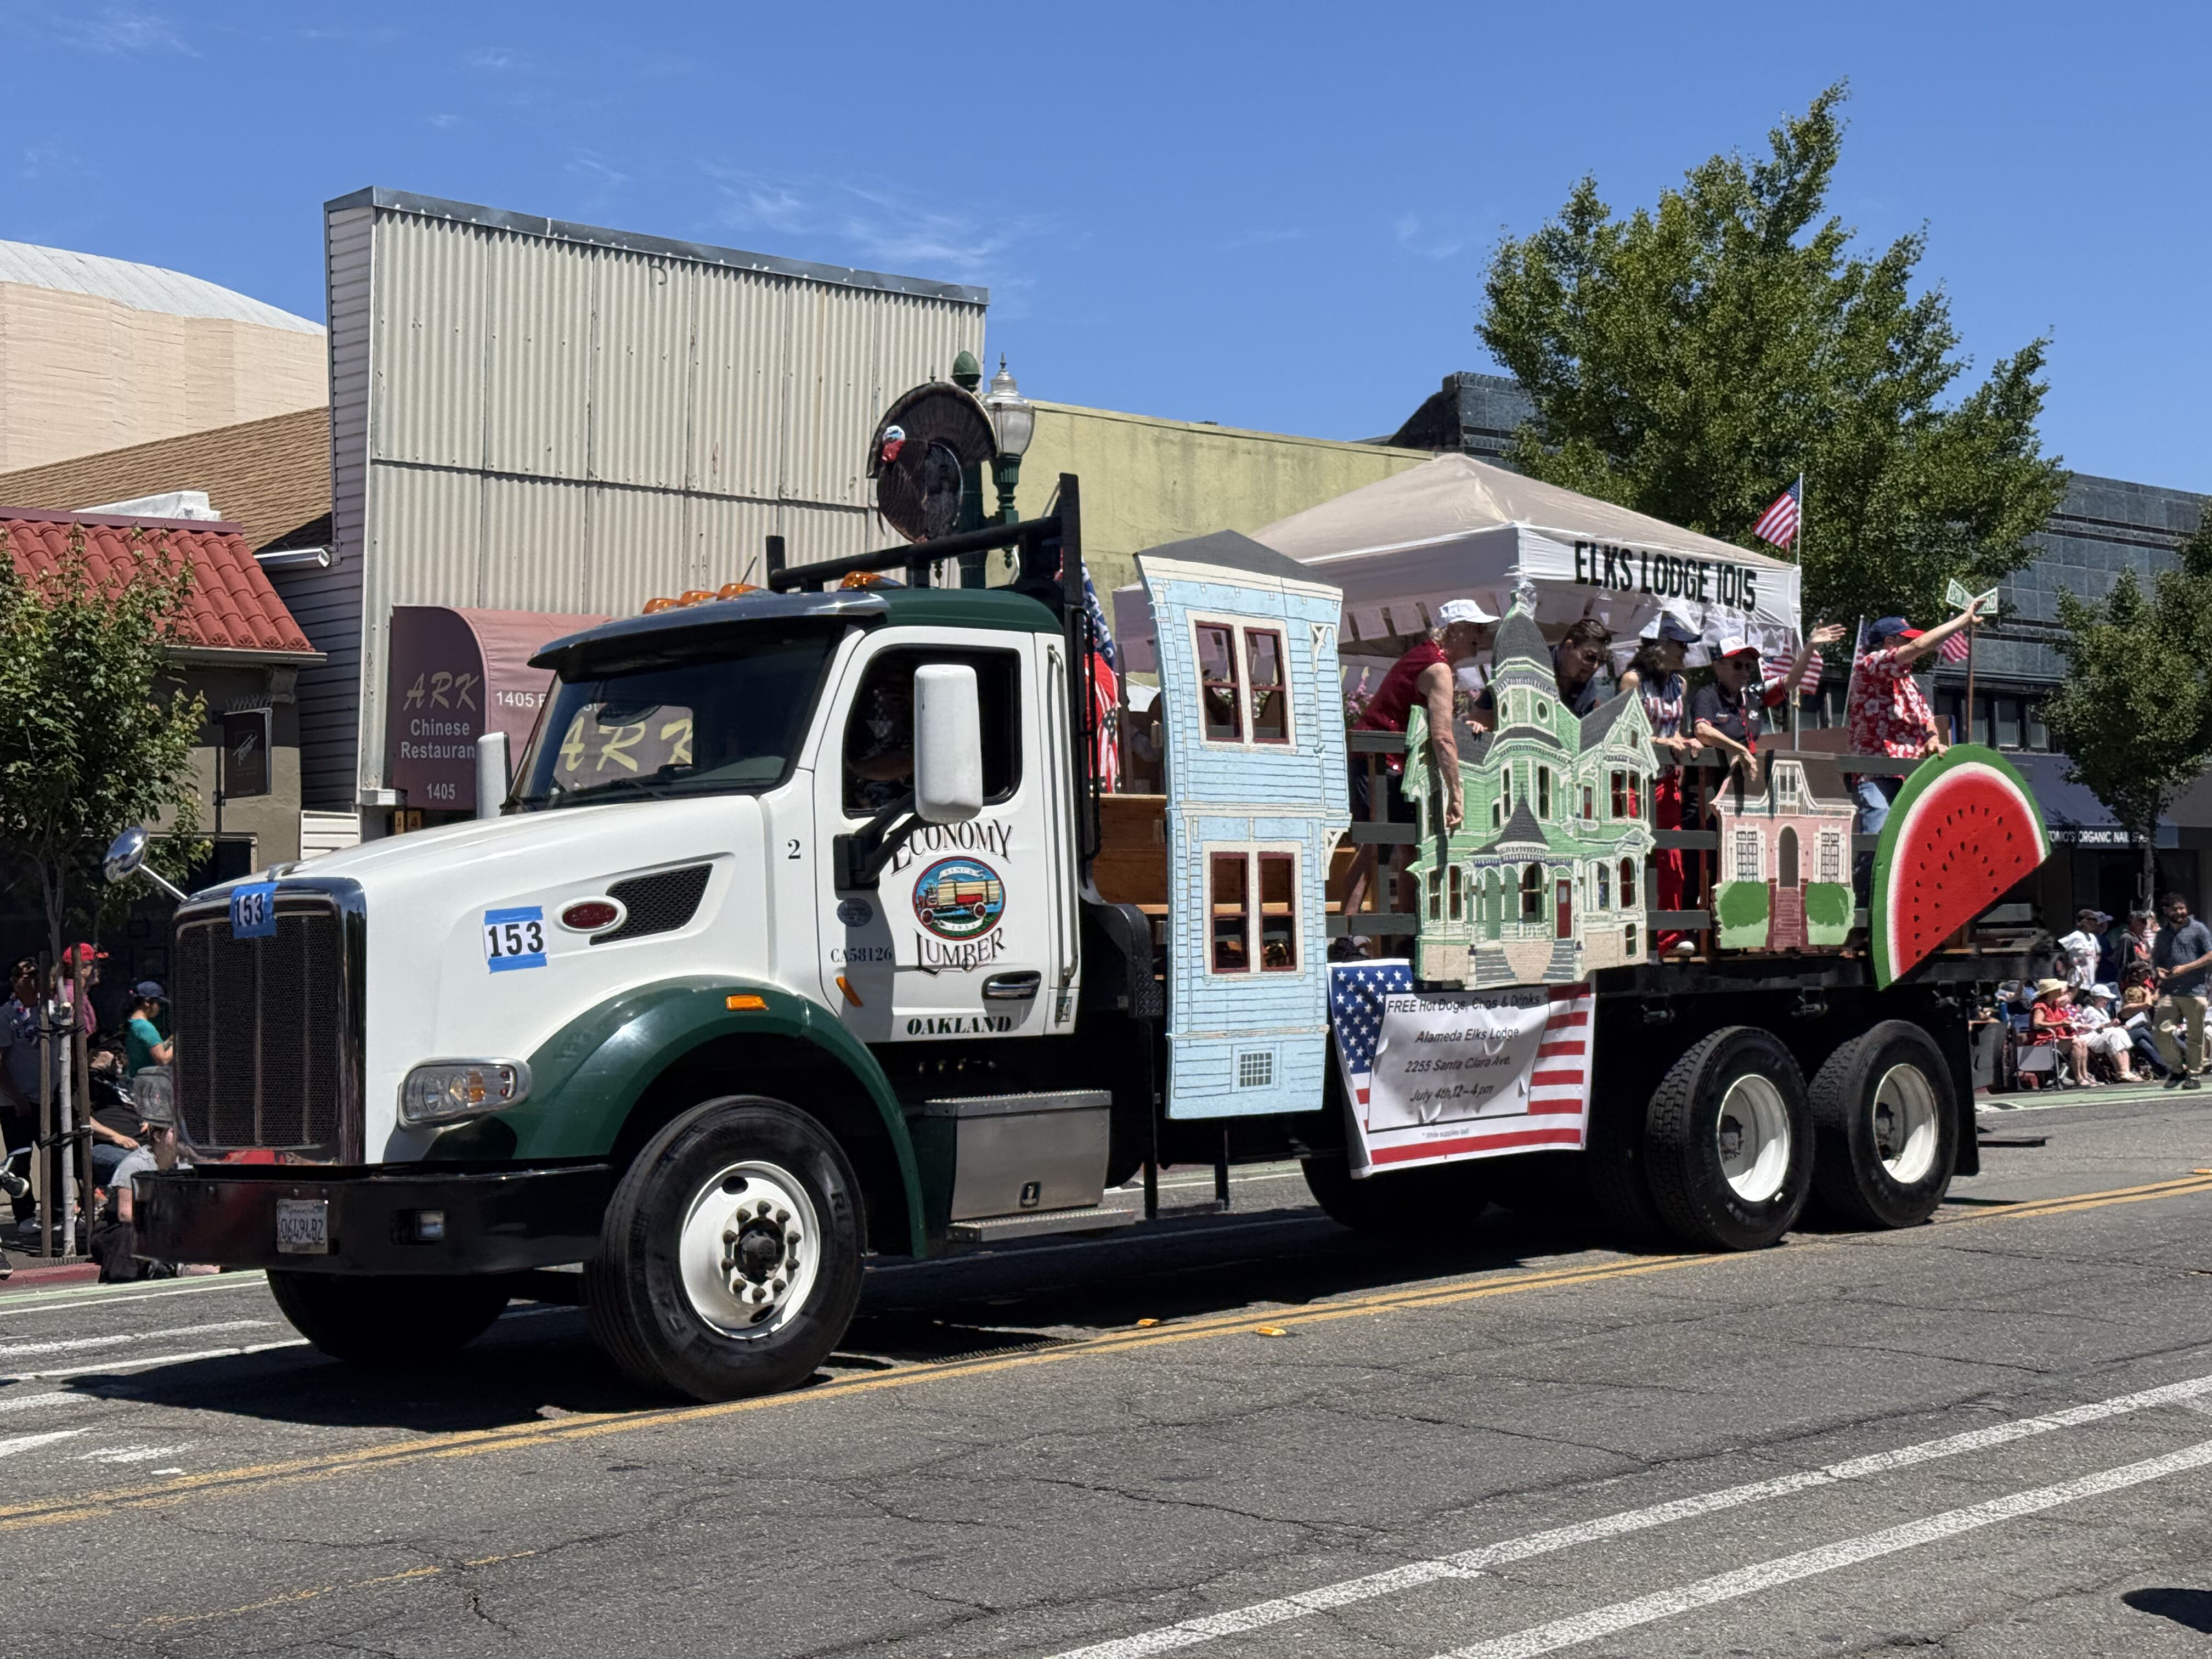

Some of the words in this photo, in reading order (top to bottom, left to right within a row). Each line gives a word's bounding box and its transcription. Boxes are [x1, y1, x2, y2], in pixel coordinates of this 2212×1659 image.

[1575, 541, 1633, 592] ELKS
[1640, 551, 1710, 603] LODGE
[1716, 563, 1757, 612] 1015
[403, 672, 479, 712] ARK
[496, 691, 534, 707] 1405
[411, 719, 470, 736] Chinese
[402, 742, 475, 759] Restauran
[427, 783, 455, 800] 1405
[2078, 831, 2112, 843] ORGANIC
[2114, 832, 2129, 843] NAIL
[788, 839, 801, 859] 2
[235, 893, 264, 927] 153
[489, 921, 544, 957] 153
[831, 947, 893, 963] CA58126
[913, 927, 1007, 978] LUMBER
[1386, 999, 1417, 1013] FREE
[1419, 998, 1436, 1012] Hot
[1438, 998, 1468, 1014] Dogs,
[1501, 995, 1509, 1008] &
[907, 1017, 1011, 1035] OAKLAND
[1415, 1029, 1463, 1042] Alameda
[1464, 1029, 1487, 1041] Elks
[1488, 1026, 1520, 1041] Lodge
[1404, 1060, 1432, 1073] 2255
[1432, 1059, 1463, 1071] Santa
[1465, 1057, 1491, 1069] Clara
[1410, 1088, 1434, 1104] July
